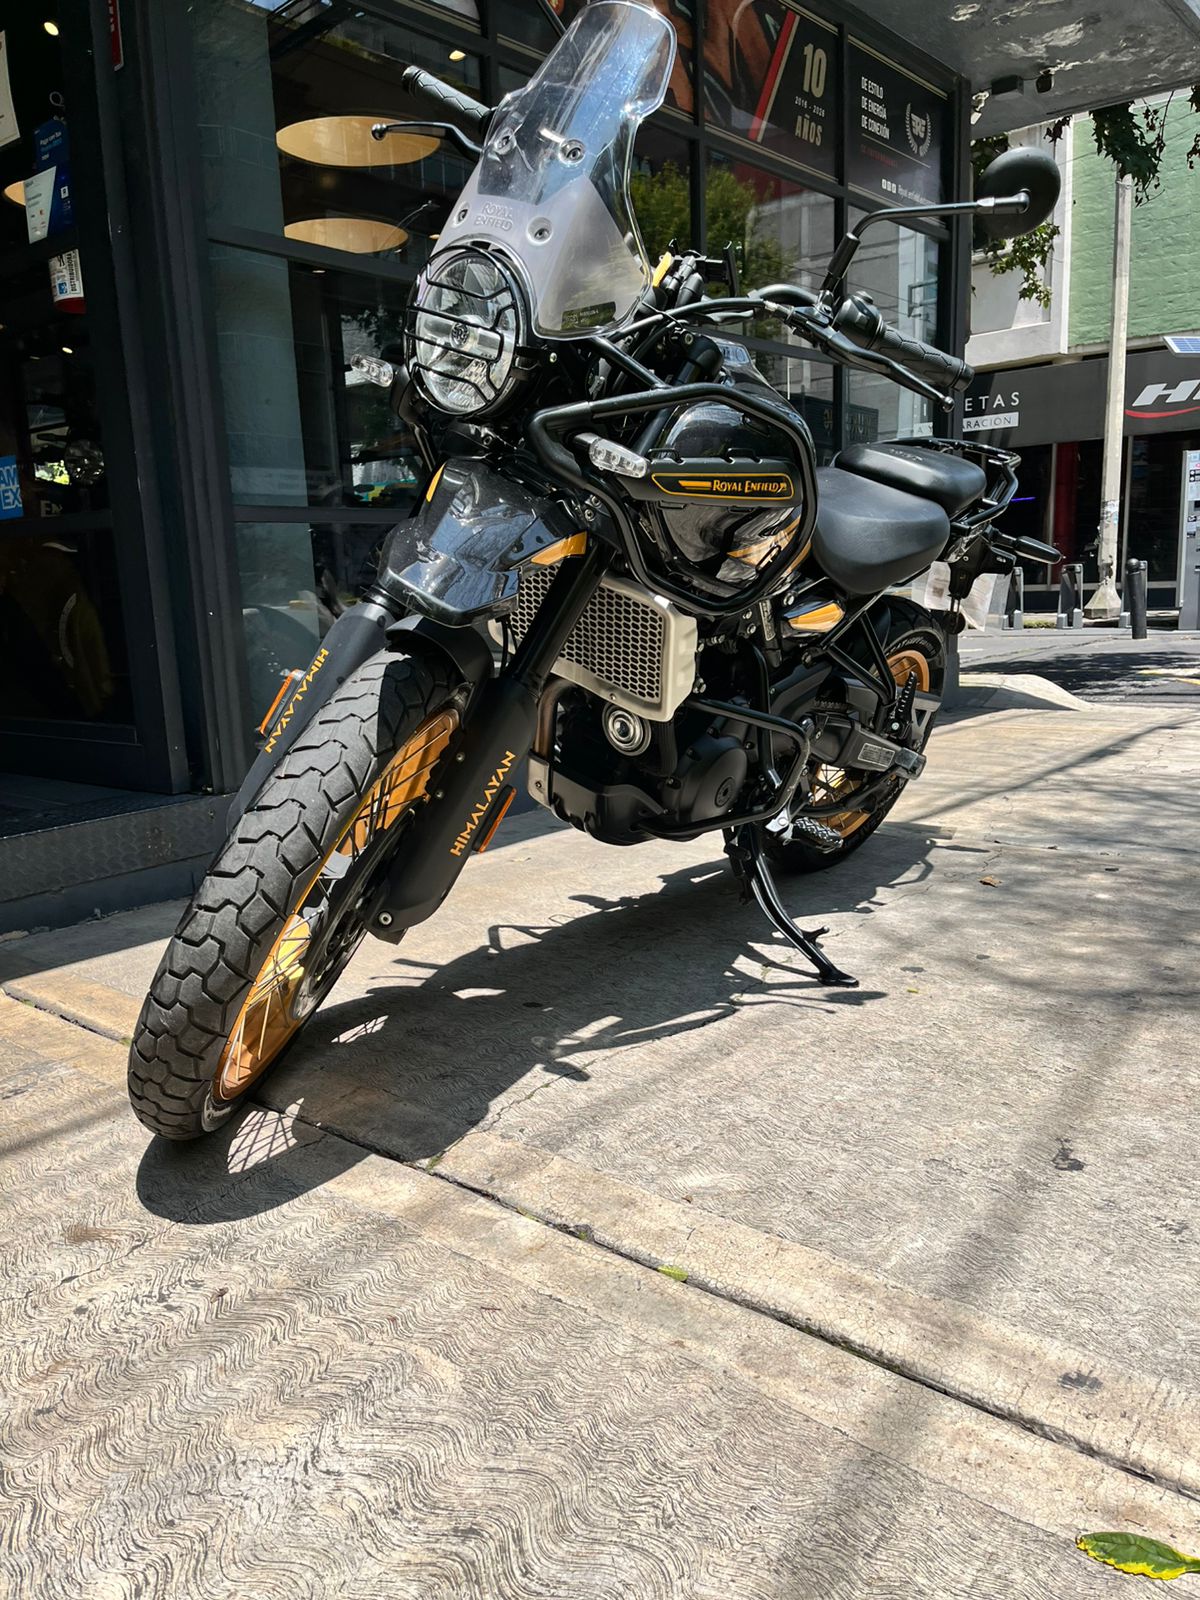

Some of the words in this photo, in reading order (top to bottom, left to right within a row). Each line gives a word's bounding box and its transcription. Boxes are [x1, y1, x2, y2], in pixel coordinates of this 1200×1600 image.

[803, 43, 827, 98] 10
[861, 76, 868, 91] DE
[868, 80, 884, 99] ESTILO
[861, 95, 868, 110] DE
[795, 114, 823, 146] AÑOS
[861, 114, 868, 129] DE
[481, 201, 513, 218] ROYAL
[473, 213, 514, 232] ENFIELD
[964, 391, 1020, 412] ETAS
[712, 479, 742, 493] ROYAL
[744, 480, 783, 494] ENFIELD
[1, 486, 23, 510] EX
[264, 647, 329, 754] HIMALAYAN
[449, 750, 516, 857] HIMALAYAN
